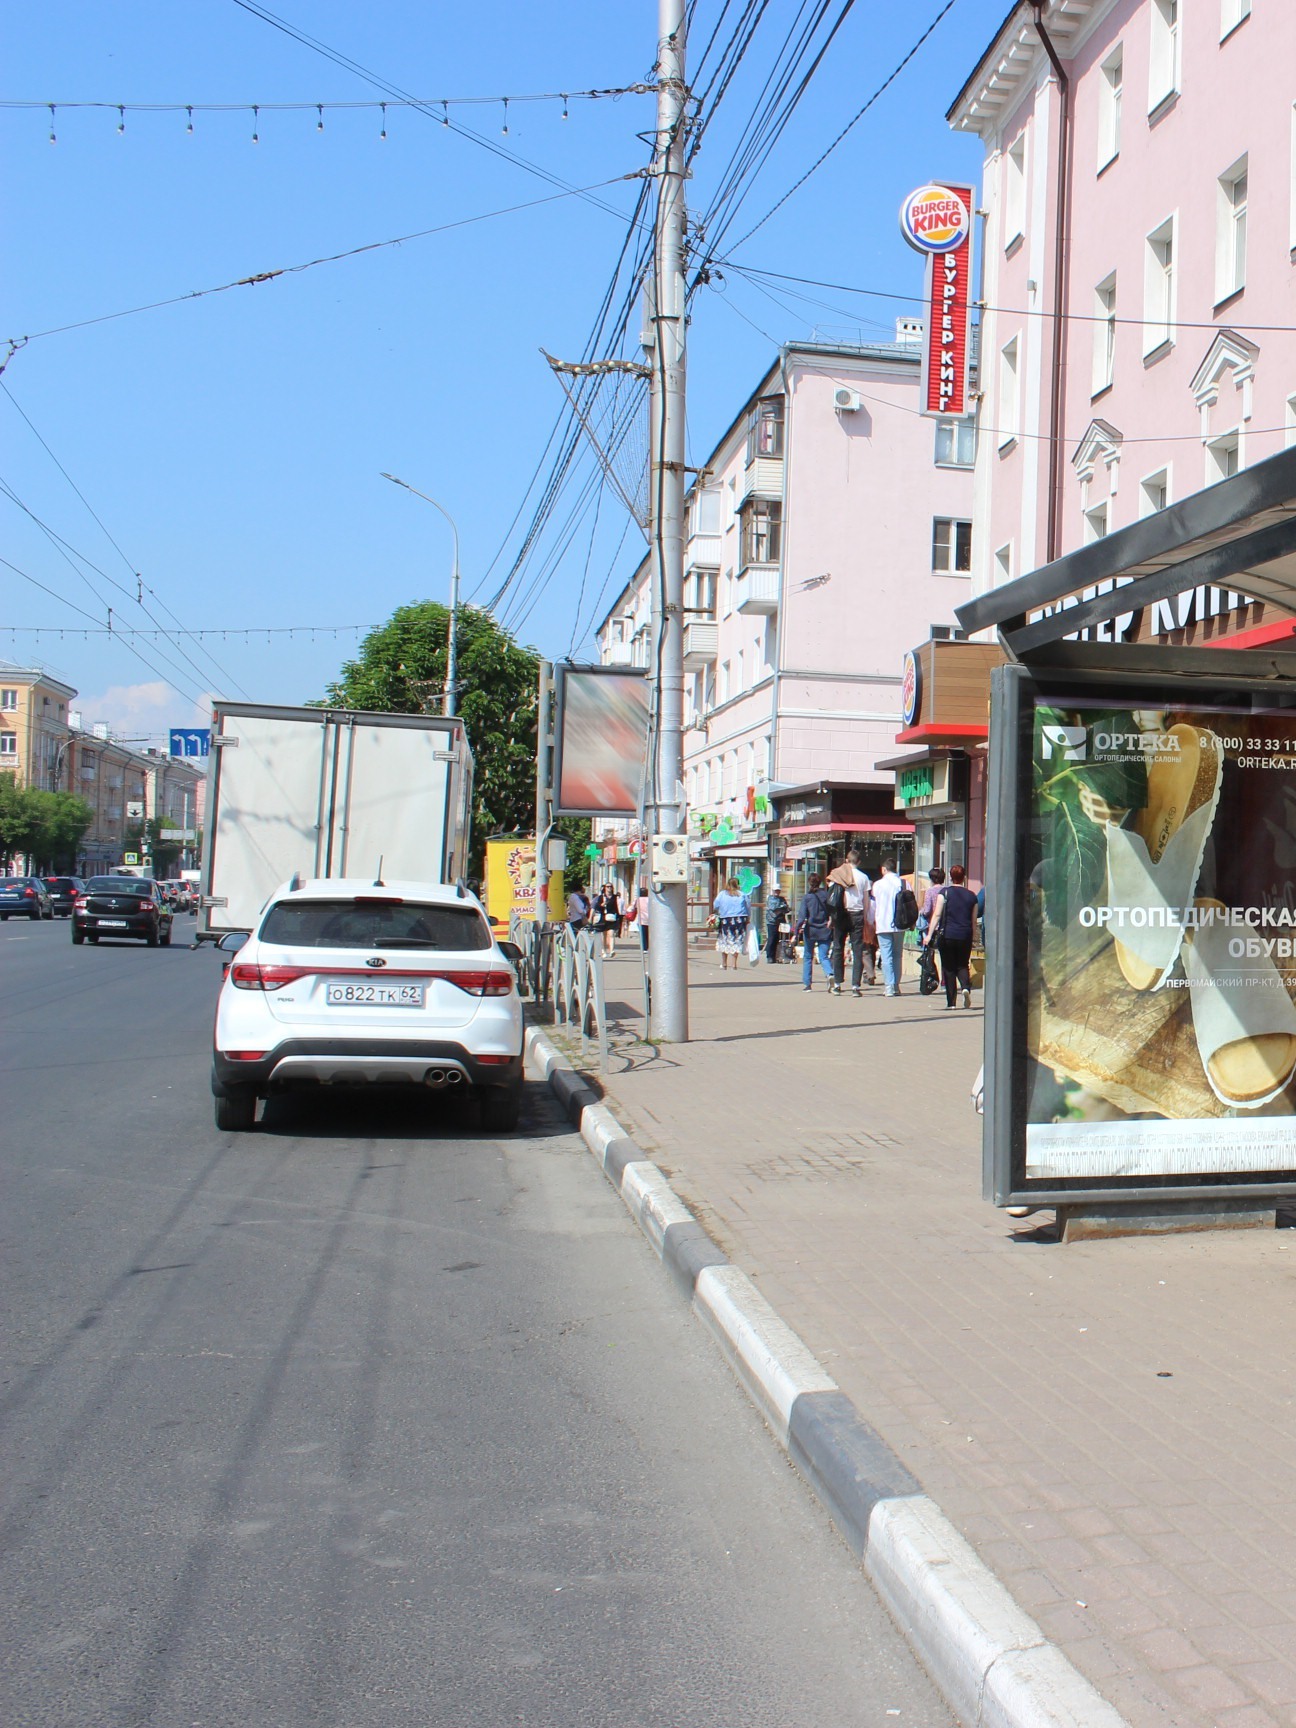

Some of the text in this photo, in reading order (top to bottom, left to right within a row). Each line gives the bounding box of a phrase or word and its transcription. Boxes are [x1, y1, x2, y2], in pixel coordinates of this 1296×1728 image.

[912, 200, 960, 218] BURGER
[913, 211, 962, 234] KING
[938, 253, 957, 411] БУРГЕР КИНГ
[1094, 732, 1181, 752] ОРТЕКА
[1199, 737, 1207, 748] 8
[1211, 736, 1243, 751] (800)
[1246, 738, 1261, 750] 33
[1264, 738, 1280, 750] 33
[1154, 754, 1182, 763] САЛОНЫ
[514, 889, 536, 898] КВА
[368, 959, 384, 967] KIA
[1166, 976, 1243, 988] ПЕРВОМАЙСКИЙ
